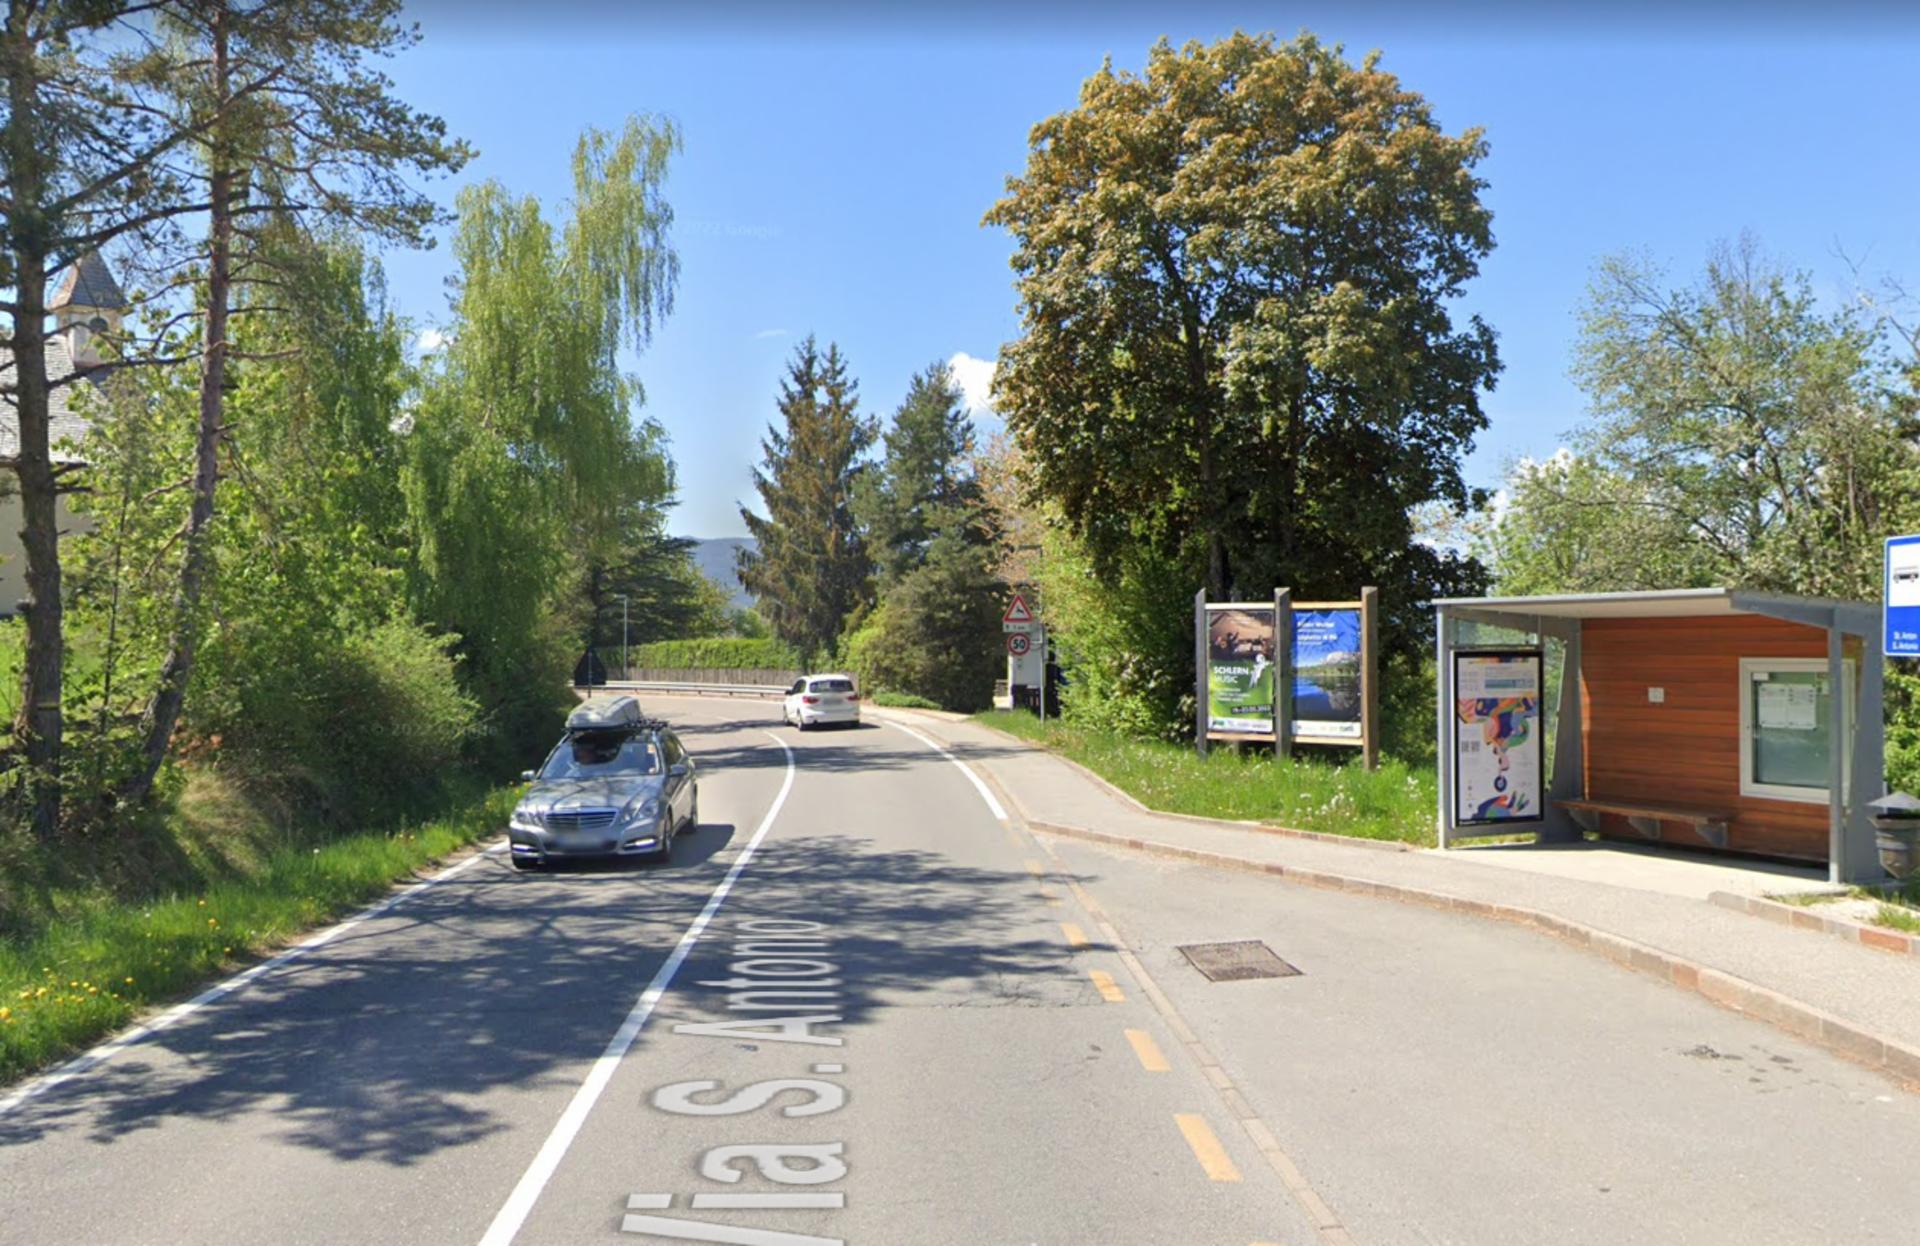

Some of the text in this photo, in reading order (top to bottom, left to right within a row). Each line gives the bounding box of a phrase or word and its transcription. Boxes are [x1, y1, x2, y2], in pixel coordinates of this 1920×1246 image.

[1013, 639, 1026, 650] 50
[1213, 666, 1249, 675] SCHLERN
[673, 919, 843, 1046] Antonio
[652, 1062, 847, 1118] S.
